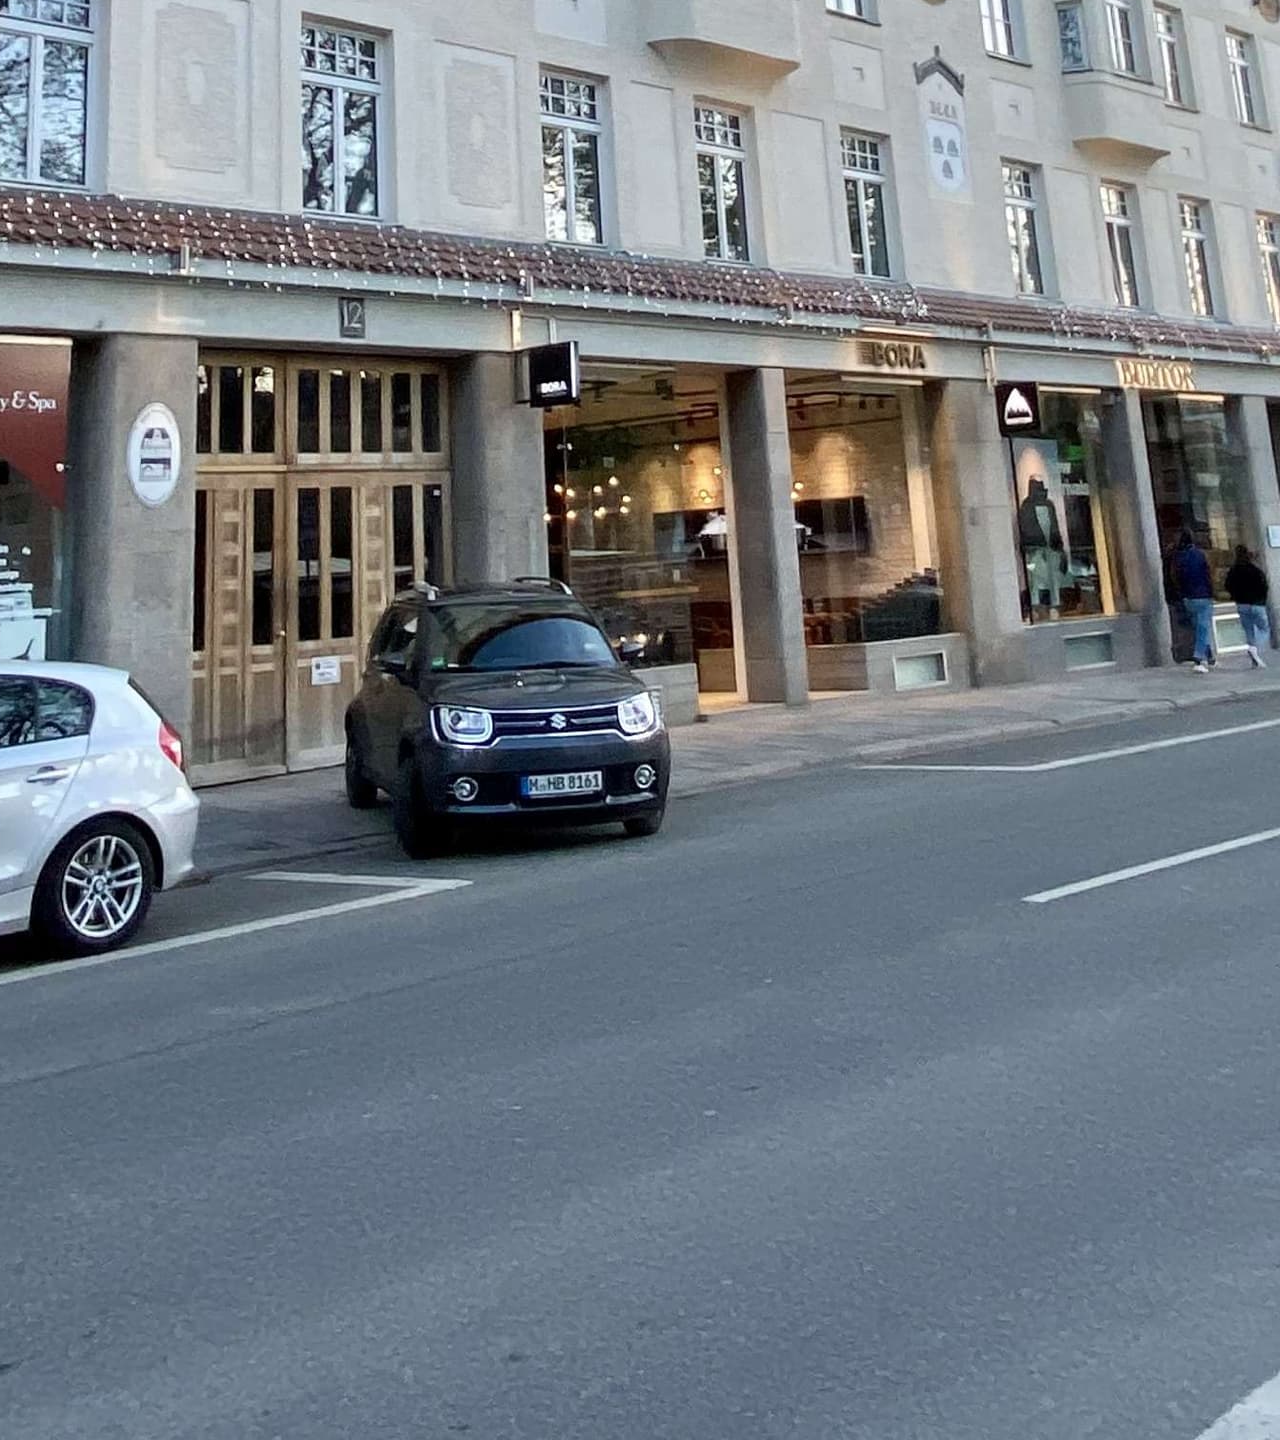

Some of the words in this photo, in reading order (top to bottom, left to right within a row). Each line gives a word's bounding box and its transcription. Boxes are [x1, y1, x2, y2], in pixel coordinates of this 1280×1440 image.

[343, 300, 362, 328] 12
[872, 342, 926, 369] BORA
[12, 390, 26, 409] &
[28, 391, 56, 413] Spa
[547, 775, 565, 790] HB
[568, 773, 600, 789] 8161
